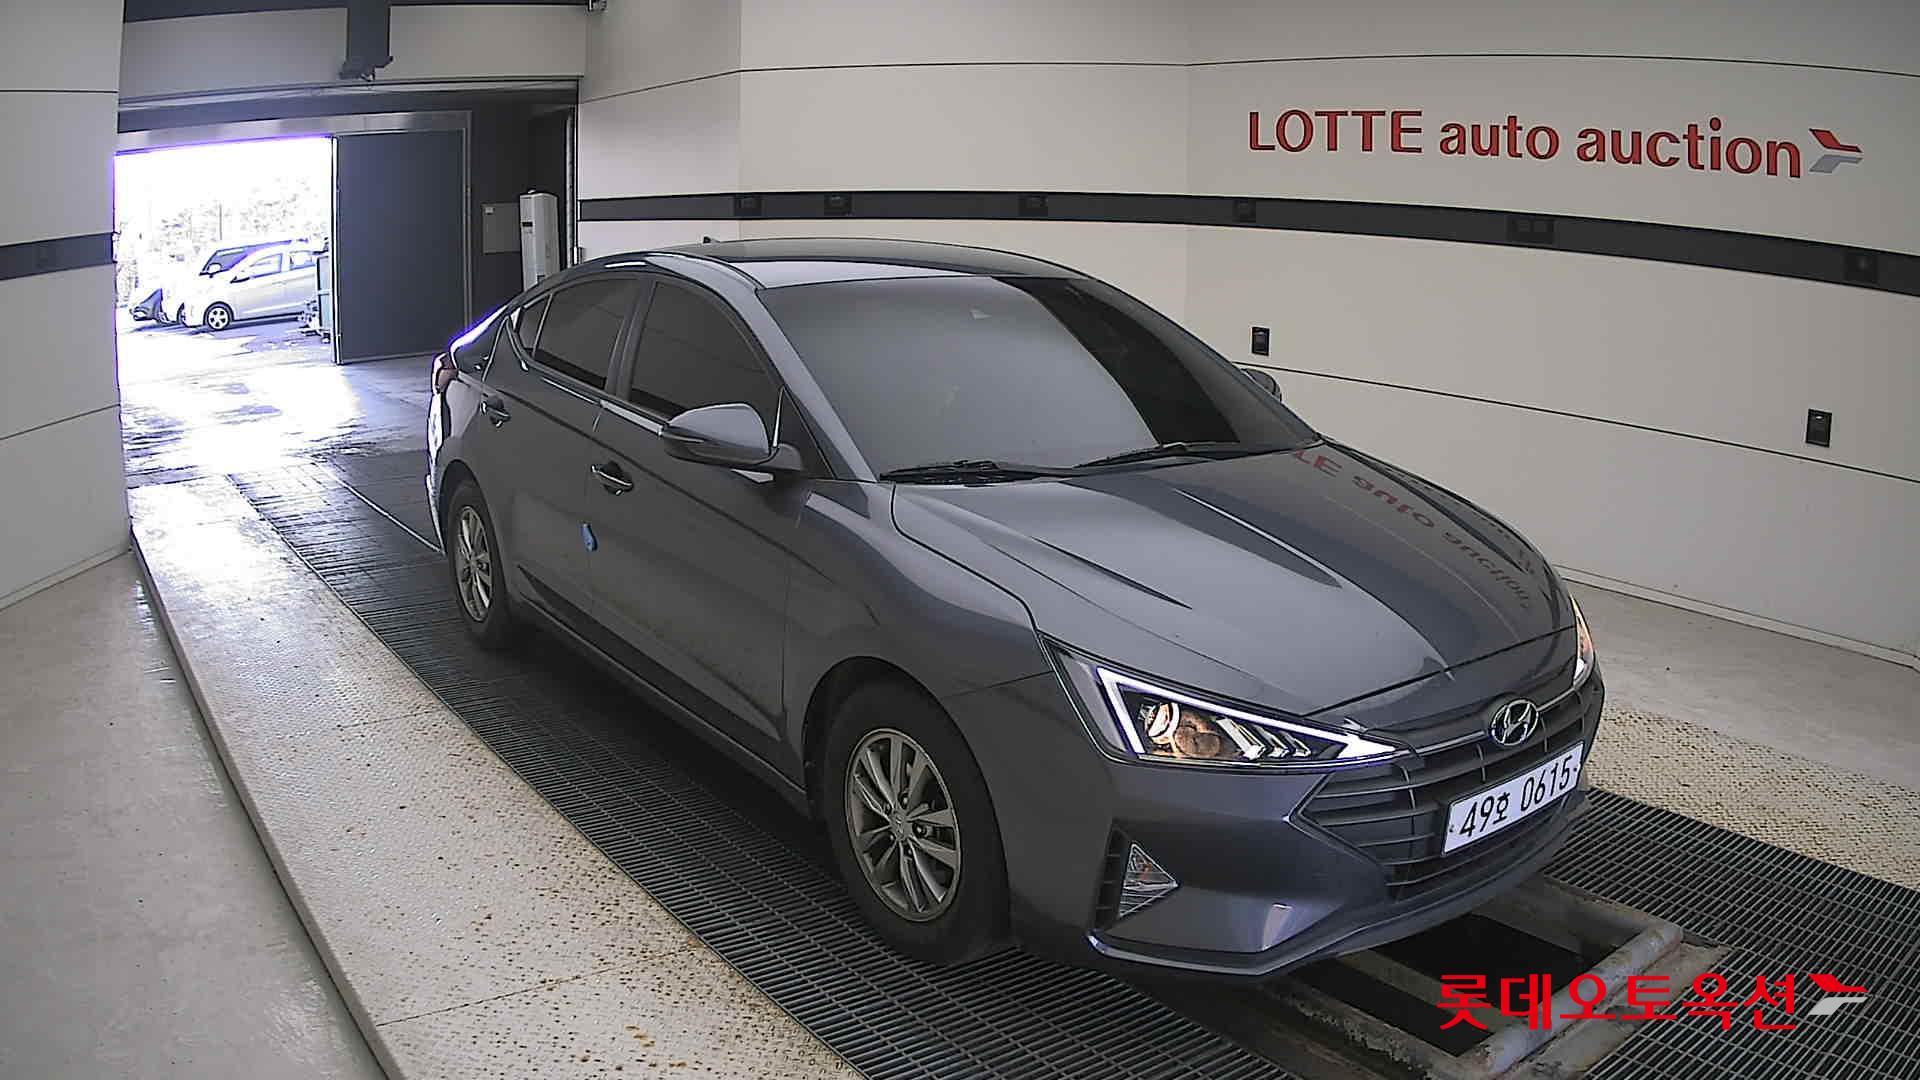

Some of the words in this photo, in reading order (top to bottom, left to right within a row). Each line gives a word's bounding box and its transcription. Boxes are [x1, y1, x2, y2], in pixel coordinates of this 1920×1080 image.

[1249, 110, 1422, 153] LOTTE
[1438, 114, 1560, 160] auto
[1576, 115, 1802, 178] auction
[1459, 791, 1511, 838] 49호
[1520, 755, 1573, 812] 0615
